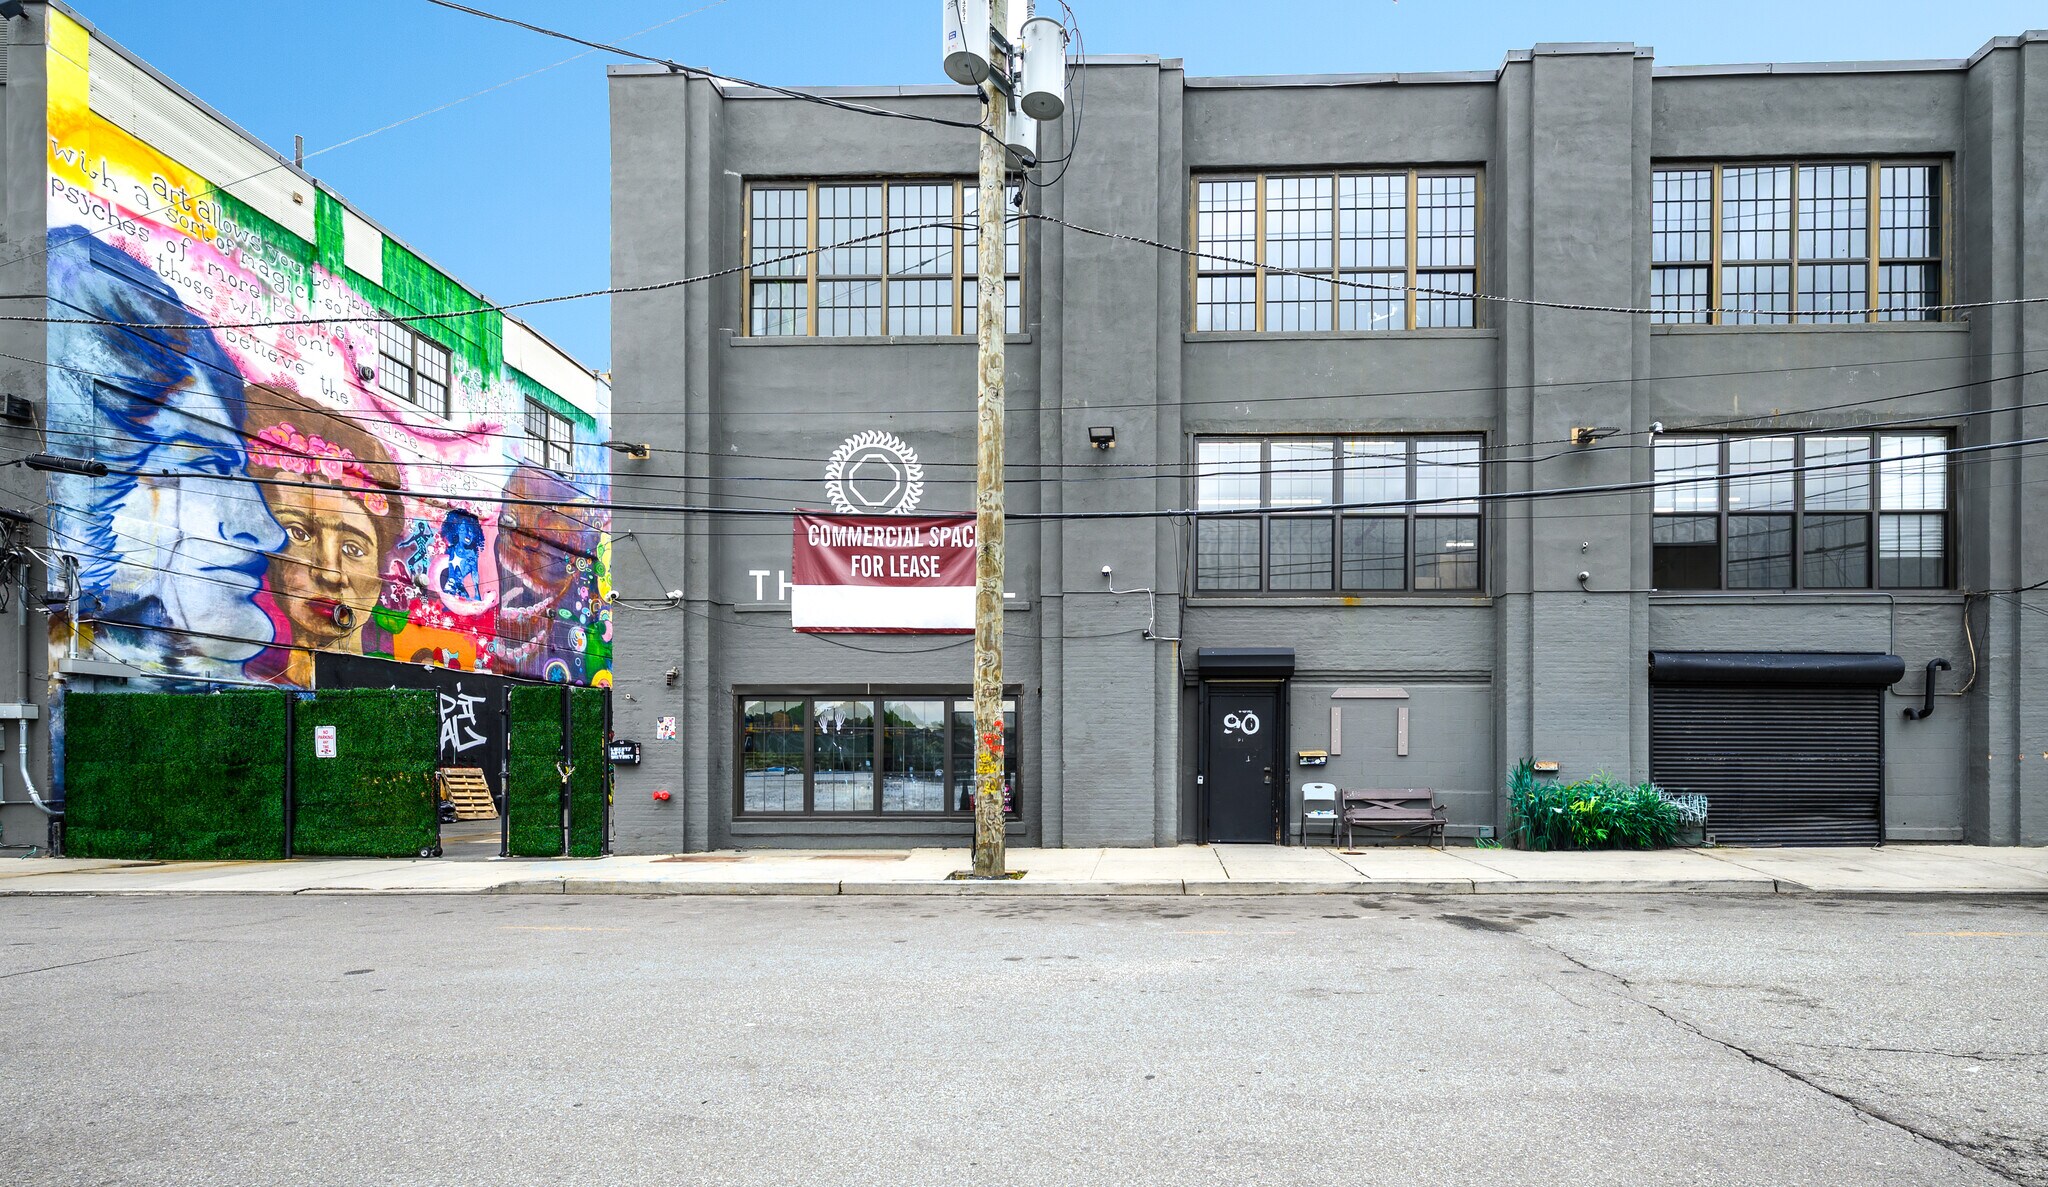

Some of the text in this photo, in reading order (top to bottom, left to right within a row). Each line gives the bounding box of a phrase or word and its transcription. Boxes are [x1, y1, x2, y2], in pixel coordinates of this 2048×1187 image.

[51, 176, 151, 243] psyches
[166, 237, 192, 262] of
[207, 262, 261, 299] more
[133, 185, 151, 211] a
[164, 207, 212, 243] sort
[216, 237, 235, 257] of
[324, 298, 342, 315] so
[153, 175, 192, 212] art
[198, 200, 262, 252] allows
[265, 243, 304, 276] you
[310, 264, 331, 291] to
[156, 253, 334, 357] those who don't
[225, 328, 306, 376] believe
[320, 374, 349, 405] the
[372, 417, 418, 450] same
[808, 524, 977, 549] COMMERCIAL SPAC
[851, 555, 941, 579] FOR LEASE
[1223, 713, 1260, 735] 90
